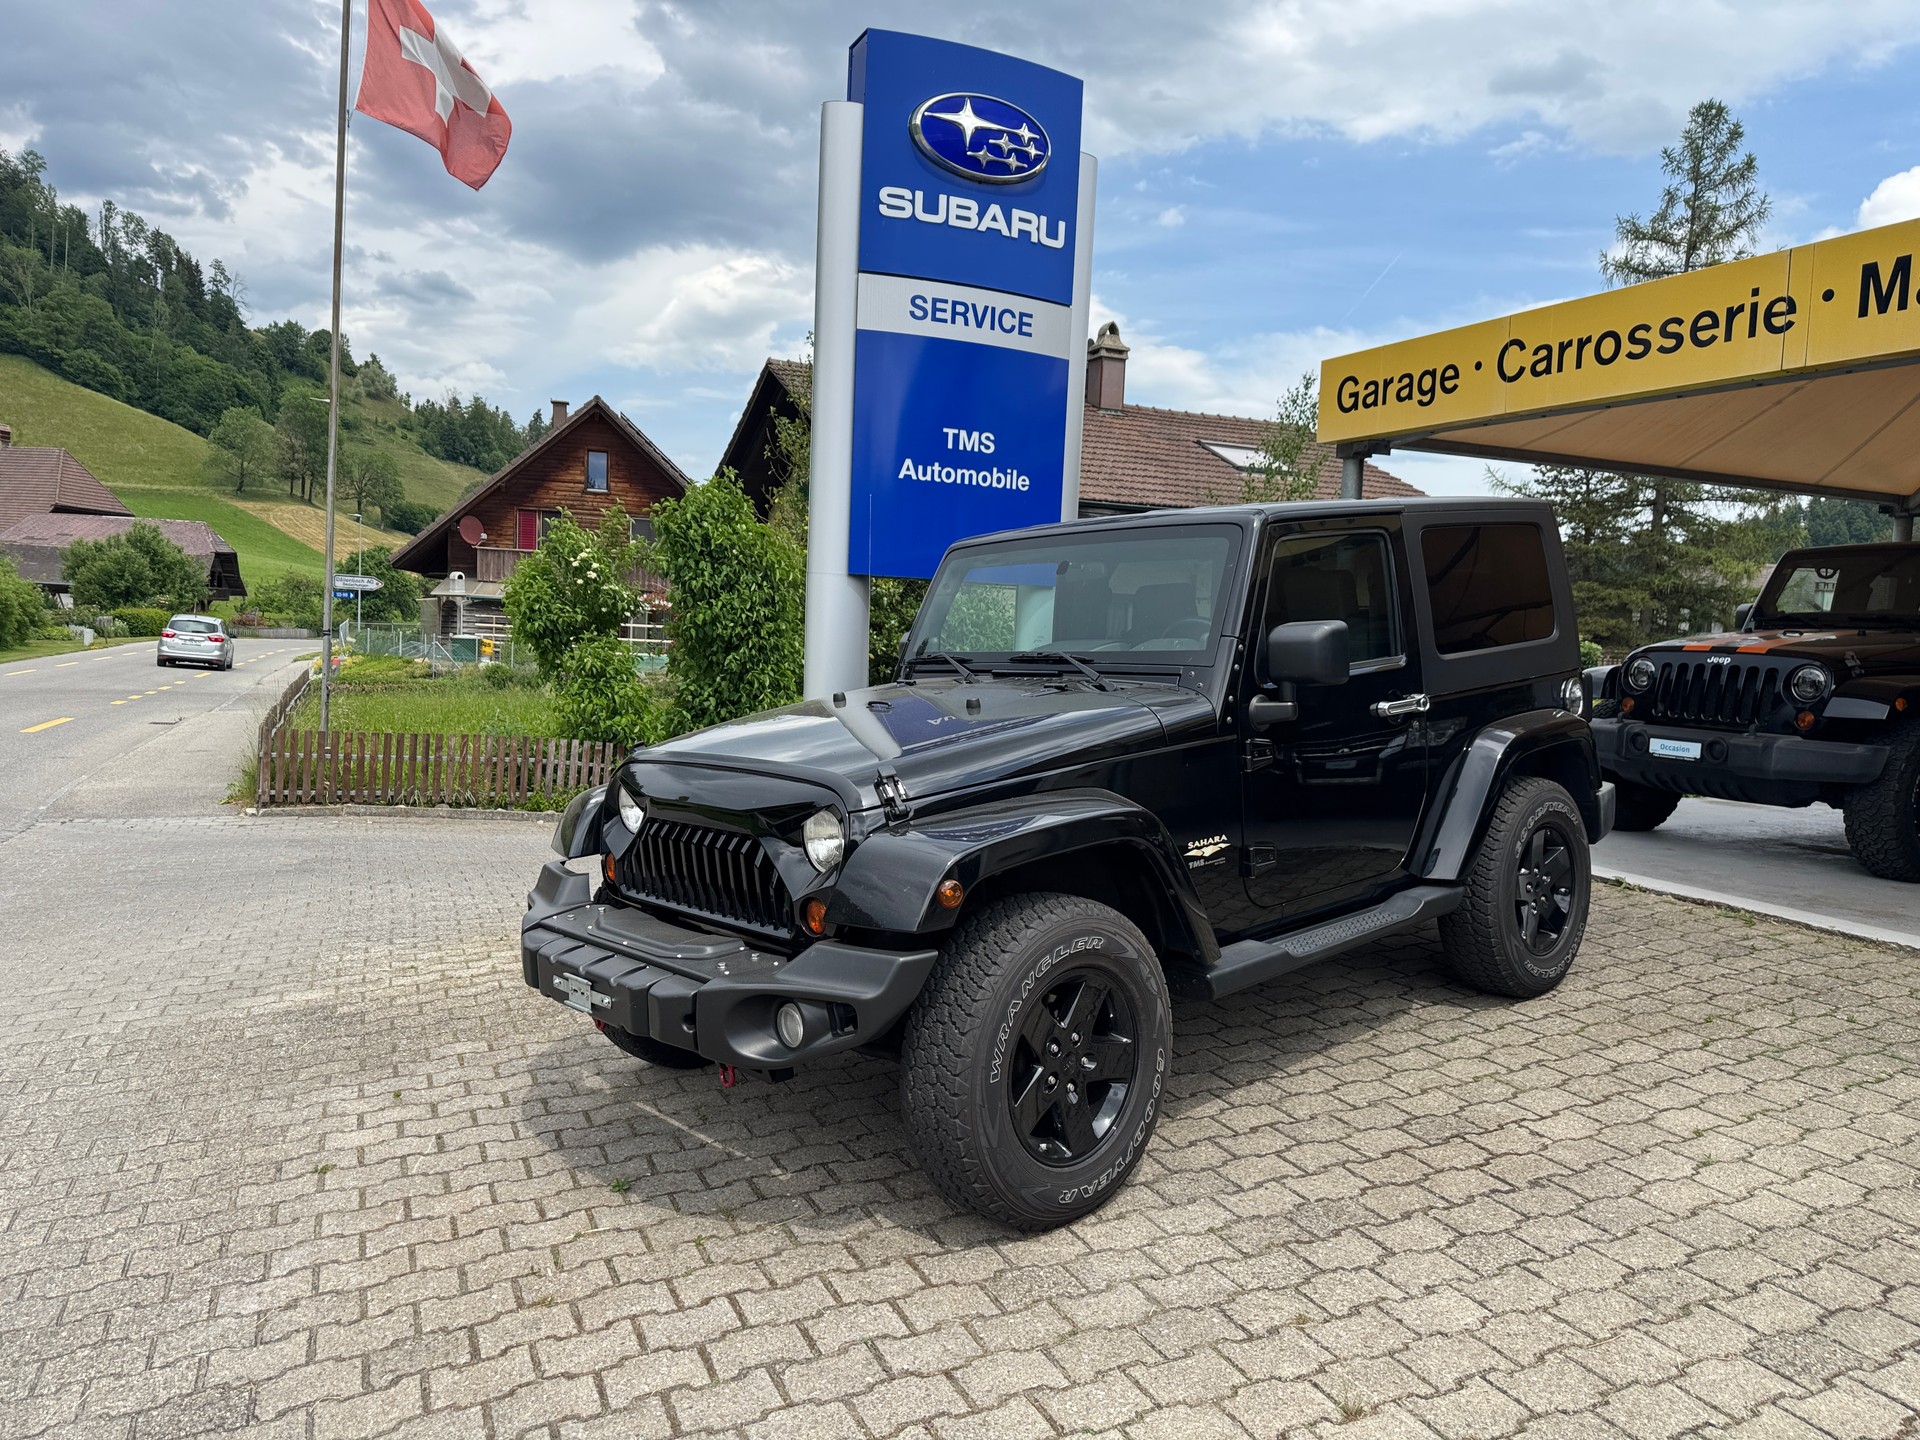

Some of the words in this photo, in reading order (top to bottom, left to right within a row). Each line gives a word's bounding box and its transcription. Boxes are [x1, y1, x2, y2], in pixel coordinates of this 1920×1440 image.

[879, 186, 1066, 249] SUBARU
[909, 294, 1034, 338] SERVICE
[1336, 363, 1460, 414] Garage
[1496, 286, 1798, 384] Carrosserie
[1857, 253, 1920, 319] M
[942, 427, 996, 454] TMS
[898, 458, 1031, 491] Automobile
[1706, 655, 1731, 665] Jeep
[1660, 743, 1691, 753] Occasion
[1187, 834, 1228, 850] SAHARA
[990, 936, 1104, 1083] WRANGLER
[1058, 1048, 1166, 1203] GOODYEAR
